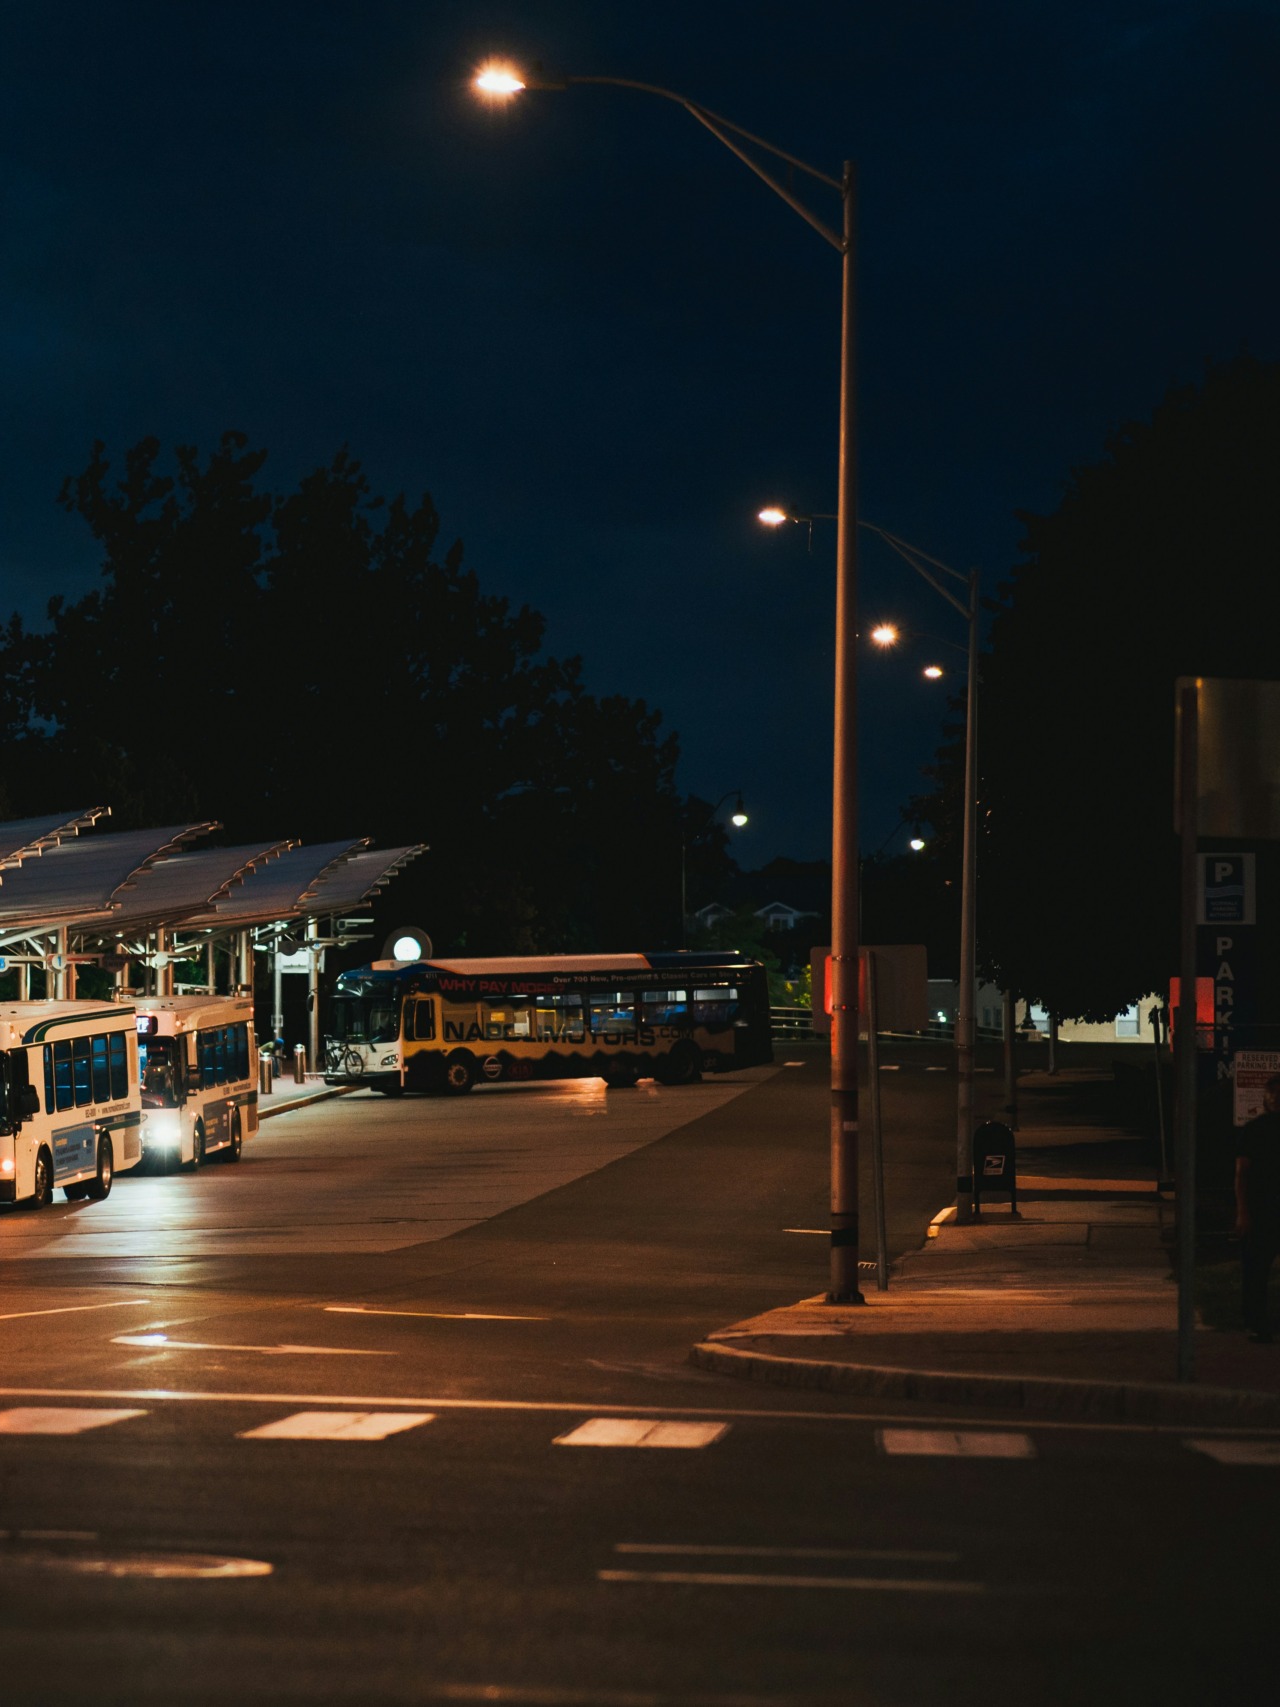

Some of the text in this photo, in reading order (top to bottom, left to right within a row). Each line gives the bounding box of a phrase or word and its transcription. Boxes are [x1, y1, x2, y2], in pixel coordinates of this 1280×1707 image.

[1215, 862, 1234, 883] P
[438, 978, 478, 992] WHY
[479, 980, 509, 993] PAY
